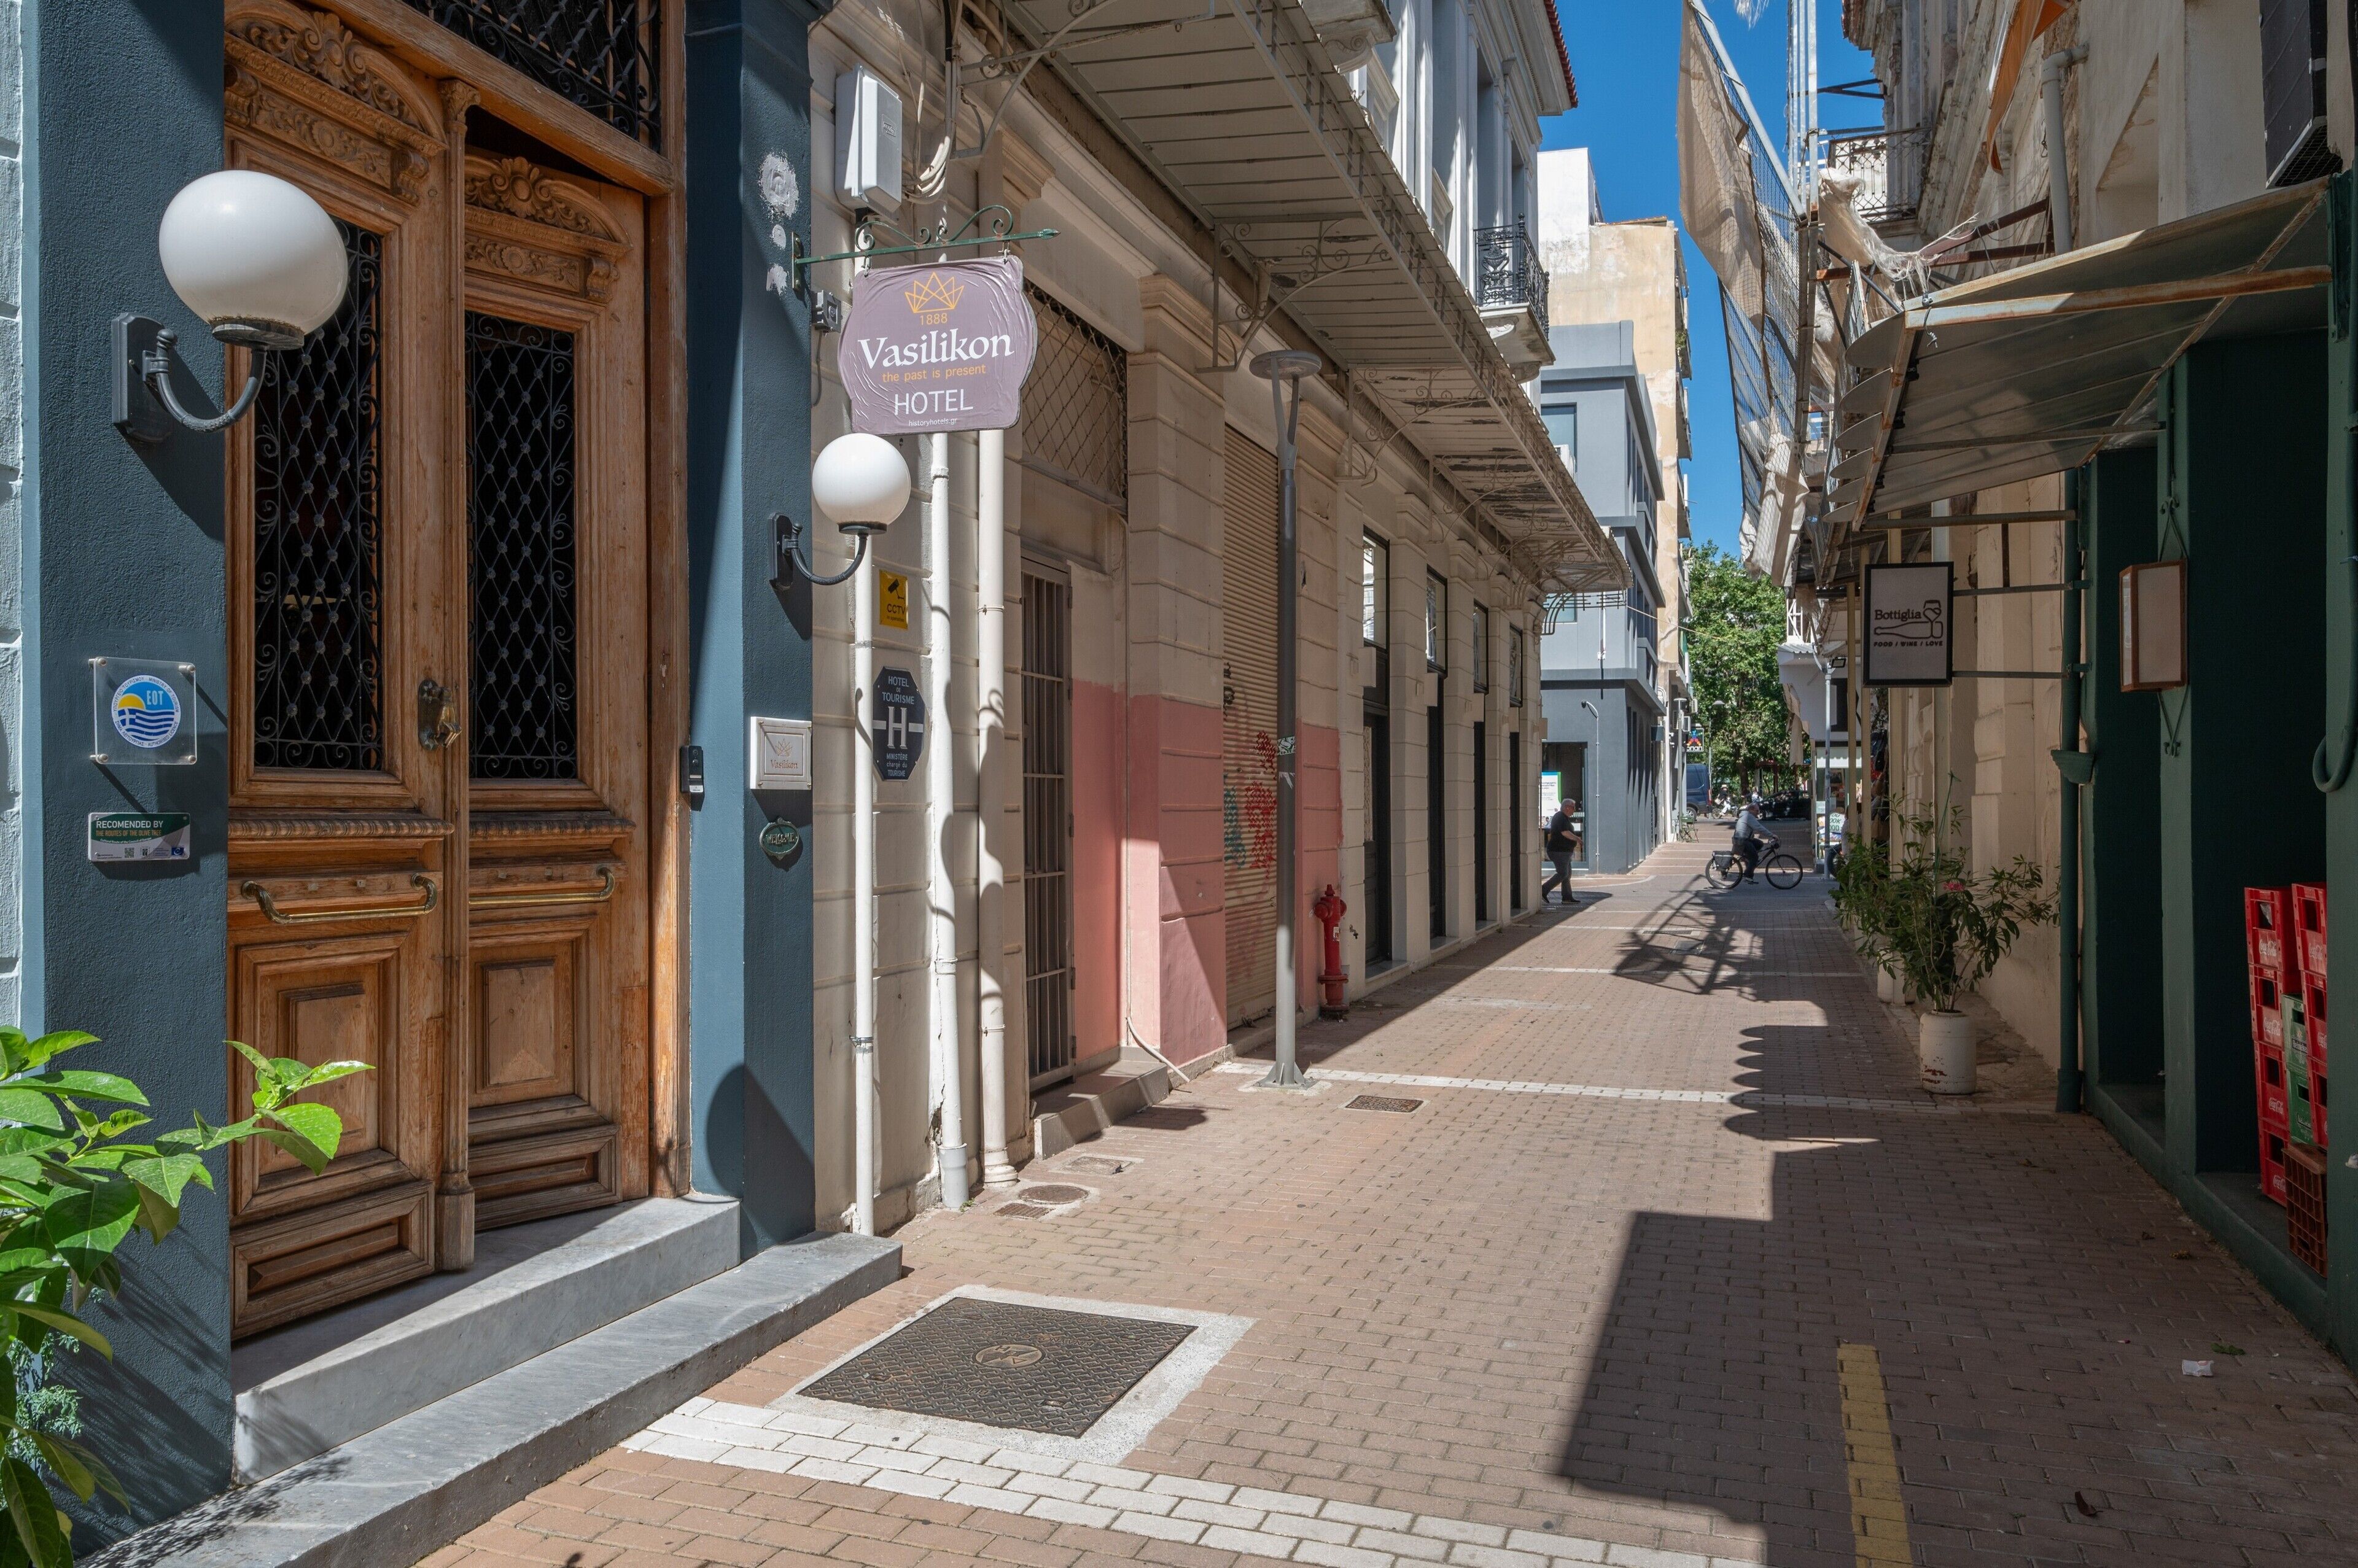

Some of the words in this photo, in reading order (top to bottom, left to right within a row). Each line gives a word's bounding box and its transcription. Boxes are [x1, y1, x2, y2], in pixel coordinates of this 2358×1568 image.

[920, 313, 947, 325] 1888
[857, 328, 1015, 369] Vasilikon
[882, 373, 900, 382] the
[905, 371, 927, 383] past
[932, 368, 941, 378] is
[946, 364, 986, 379] present
[895, 389, 973, 416] HOTEL
[908, 417, 958, 427] historyhotels.gr
[887, 604, 906, 615] CCTV
[1875, 609, 1922, 621] Bottiglia
[122, 677, 144, 689] ΤΟΥΡΙΣΜΟΥ
[149, 677, 166, 689] MINISTRY
[888, 676, 909, 687] HOTEL
[882, 692, 914, 705] TOURISME
[887, 707, 908, 749] H
[886, 752, 908, 761] MINISTÈRE
[771, 759, 798, 769] Vasilikon
[96, 820, 151, 829] RECOMENDED
[766, 833, 795, 844] WELCOME
